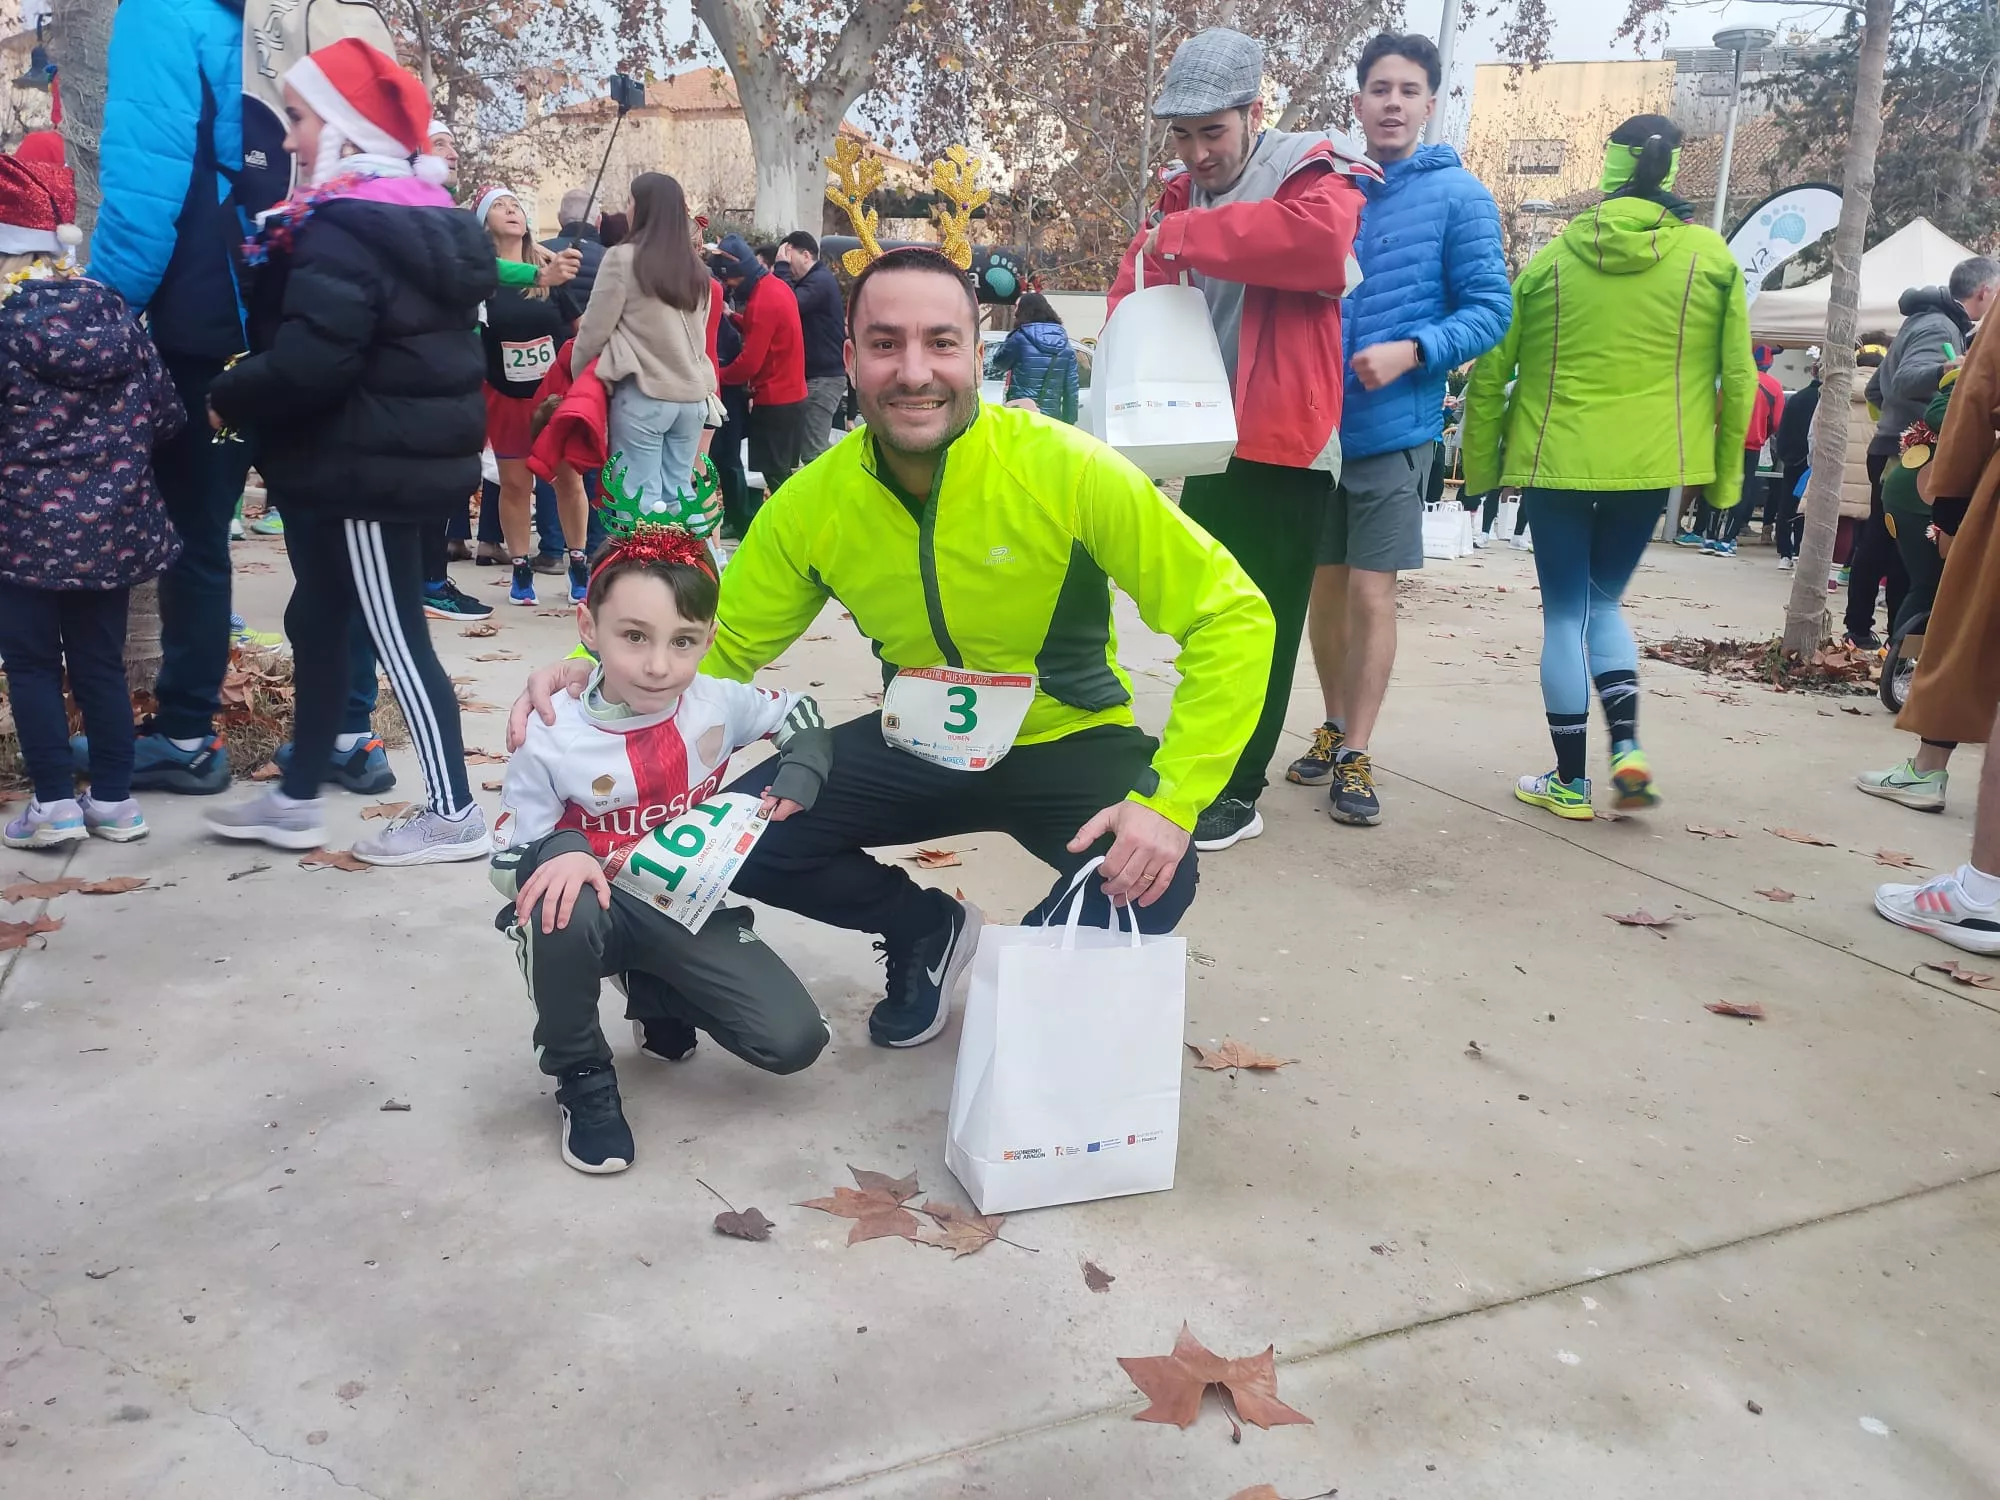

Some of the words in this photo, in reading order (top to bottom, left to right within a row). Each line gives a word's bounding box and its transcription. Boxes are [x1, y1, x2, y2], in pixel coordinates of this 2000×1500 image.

[511, 343, 550, 368] 256
[945, 671, 973, 684] HUESCA
[974, 676, 992, 685] 2025
[944, 686, 978, 734] 3
[630, 802, 733, 893] 161
[695, 837, 717, 867] LORENZO
